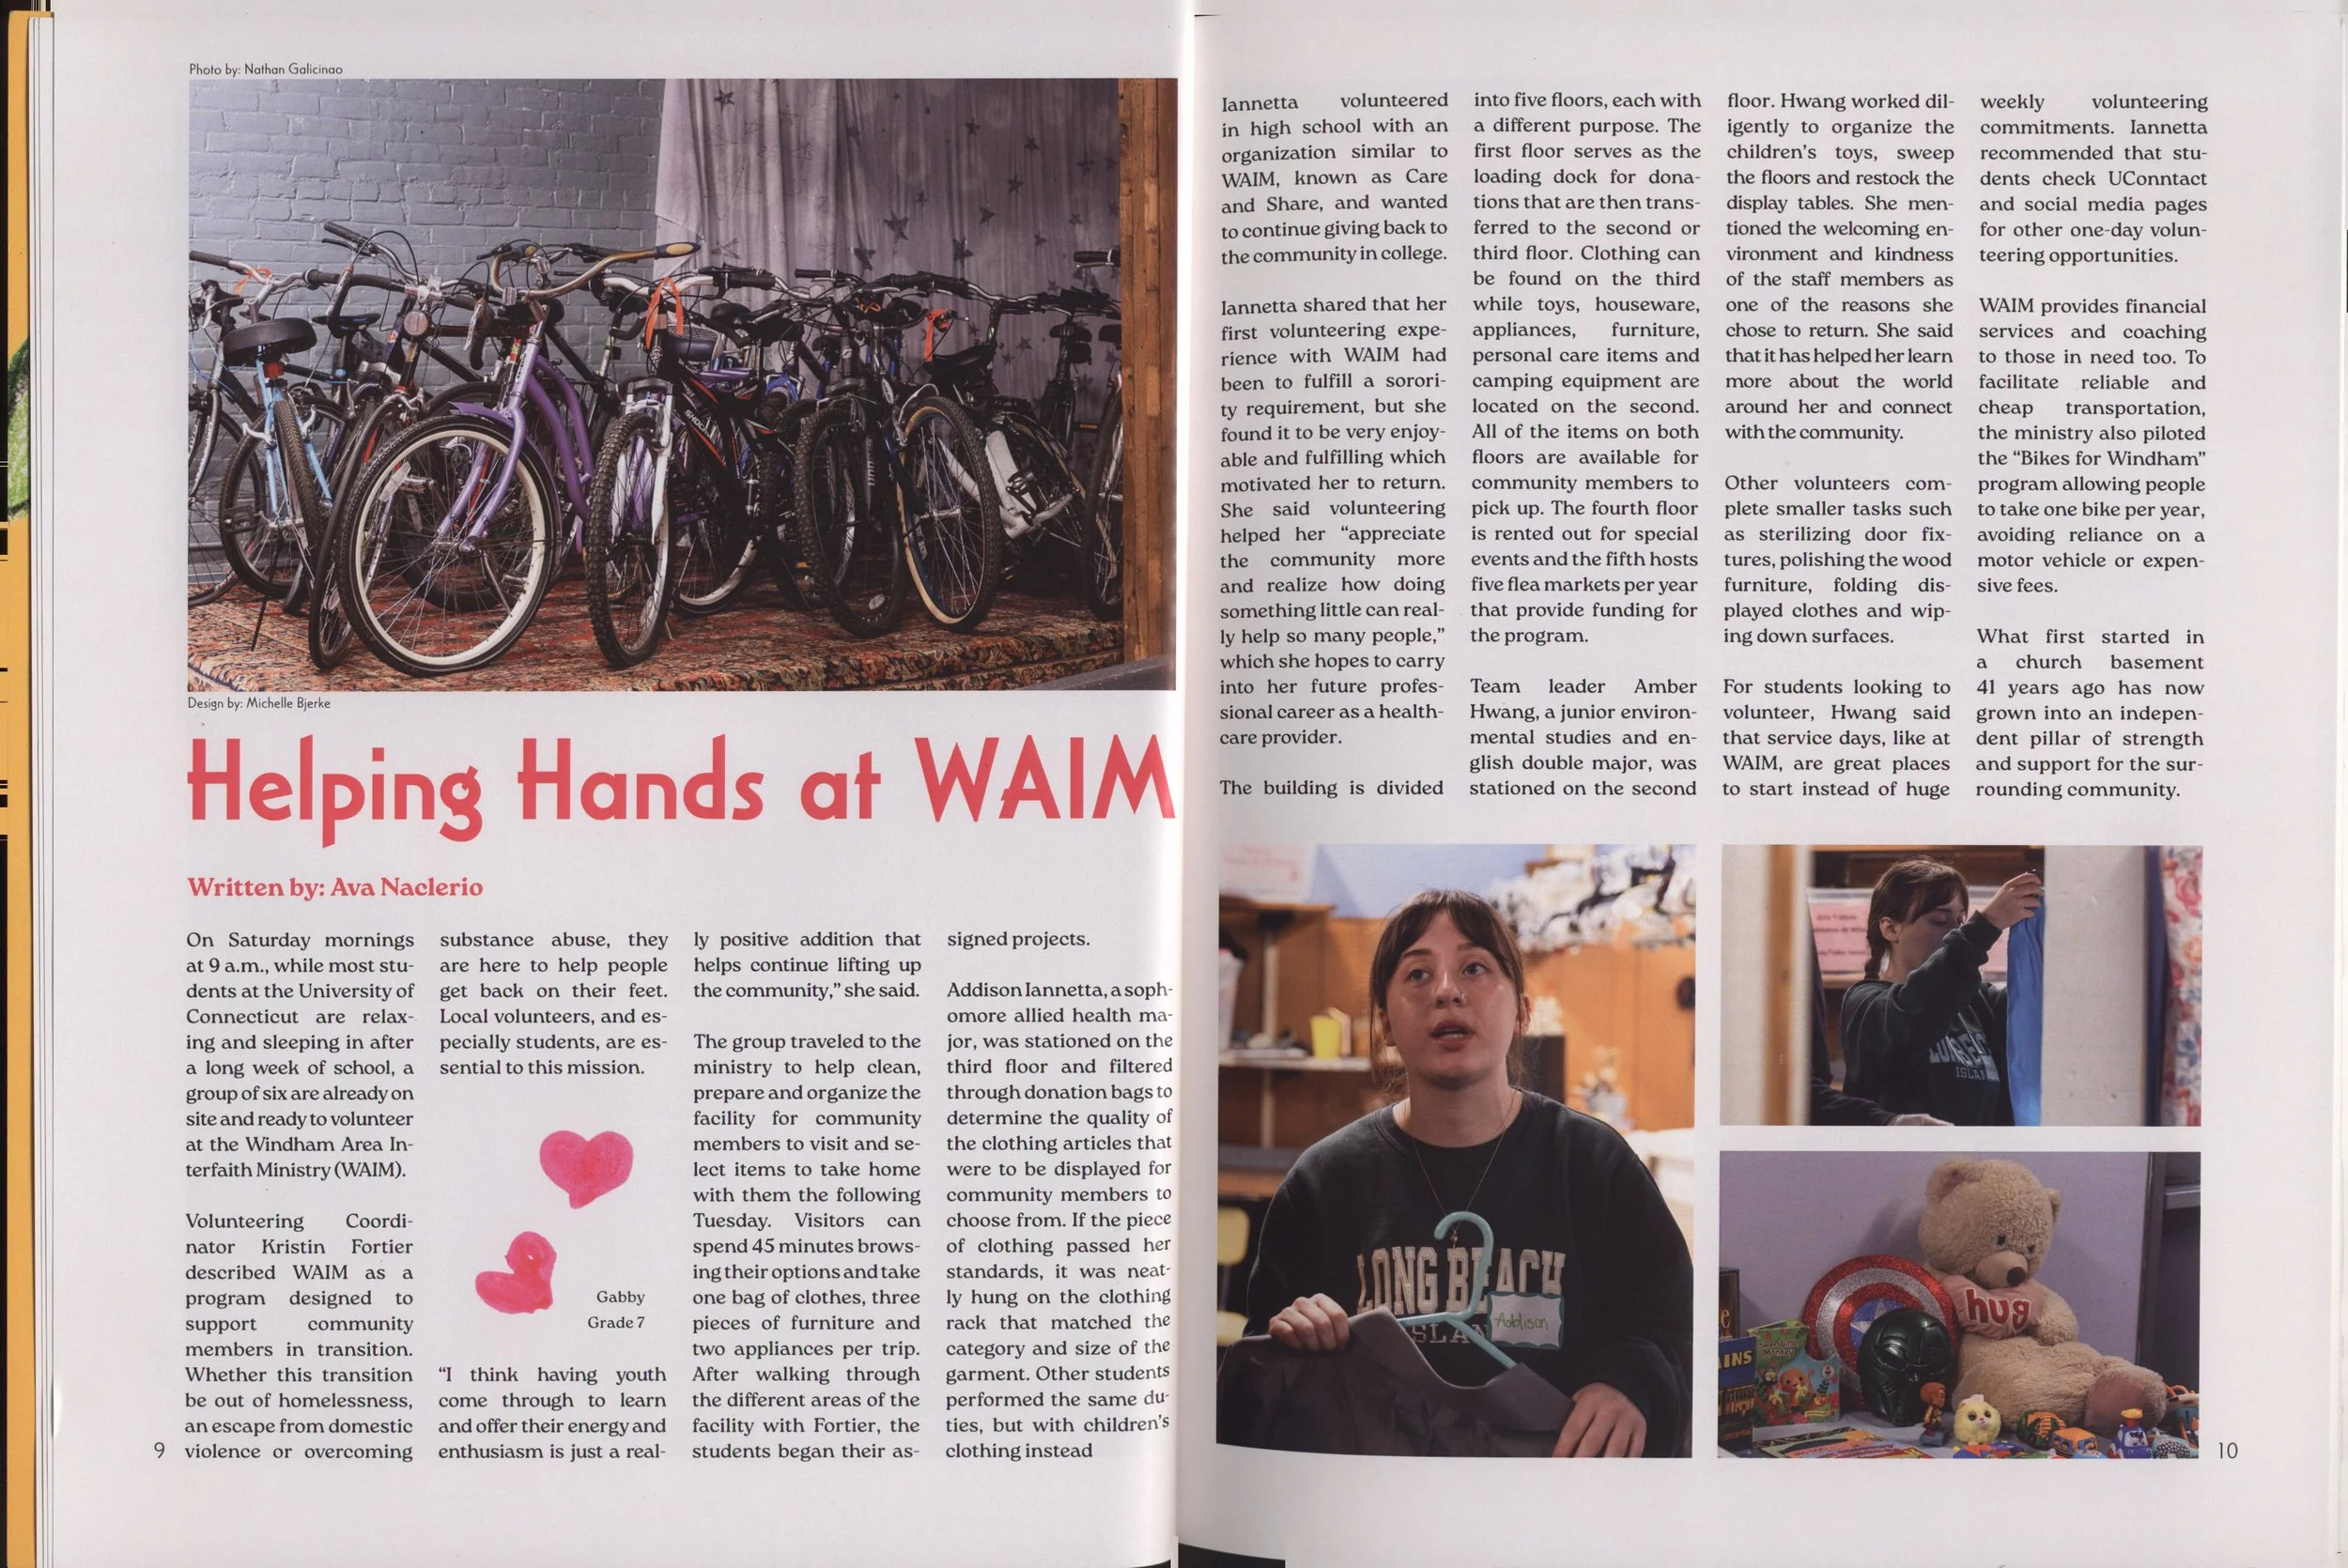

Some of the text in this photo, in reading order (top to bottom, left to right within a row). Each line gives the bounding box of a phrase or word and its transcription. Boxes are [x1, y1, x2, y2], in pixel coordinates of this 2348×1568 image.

[190, 63, 343, 78] Photo by: Nathan Galicinao
[1223, 92, 1448, 112] Iannetta volunteered
[1981, 119, 2208, 134] commitments. Iannetta
[1222, 169, 1447, 188] WAIM, known as Care
[1475, 169, 1700, 187] loading dock for dona-
[1727, 170, 1954, 185] the floors and restock the
[1726, 246, 1954, 261] vironment and kindness
[1980, 298, 2206, 316] WAIM provides financial
[1473, 322, 1699, 340] appliances, furniture,
[1221, 398, 1445, 421] ty requirement, but she
[1725, 424, 1903, 443] with the community.
[1472, 475, 1698, 493] community members to
[1979, 476, 2205, 495] program allowing people
[1221, 500, 1445, 518] She said volunteering
[1977, 680, 2204, 699] 41 years ago has now
[189, 697, 330, 711] Design by: Michelle Bjerke
[1471, 704, 1696, 722] Hwang, a junior environ-
[1220, 730, 1341, 747] care provider.
[1722, 756, 1950, 774] WAIM, are great places
[188, 734, 1175, 848] Helping Hands at WAIM
[1976, 782, 2180, 800] rounding community.
[188, 878, 483, 901] Written by: Ava Naclerio
[187, 932, 414, 950] On Saturday mornings
[440, 932, 668, 950] substance abuse, they
[948, 931, 1089, 949] signed projects.
[694, 957, 921, 976] helps continue lifting up
[187, 1009, 413, 1023] Connecticut are relax-
[440, 1008, 667, 1025] Local volunteers, and es-
[947, 1058, 1172, 1073] third floor and filtered
[187, 1112, 413, 1130] site and ready to volunteer
[694, 1111, 921, 1129] facility for community
[947, 1187, 1171, 1206] community members to
[186, 1213, 412, 1232] Volunteering Coordi-
[1357, 1246, 1438, 1315] LONG
[597, 1291, 644, 1305] Gabby
[1965, 1287, 2031, 1331] hug
[588, 1316, 644, 1329] Grade 7
[947, 1314, 1170, 1330] rack that matched the
[1494, 1313, 1549, 1331] Addison
[1763, 1348, 1794, 1358] Monkey
[439, 1392, 666, 1411] come through to learn
[439, 1418, 666, 1437] and offer their energy and
[154, 1442, 164, 1458] 9
[185, 1444, 412, 1462] violence or overcoming
[692, 1443, 919, 1462] students began their as-
[946, 1443, 1092, 1461] clothing instead
[2219, 1442, 2238, 1458] 10
